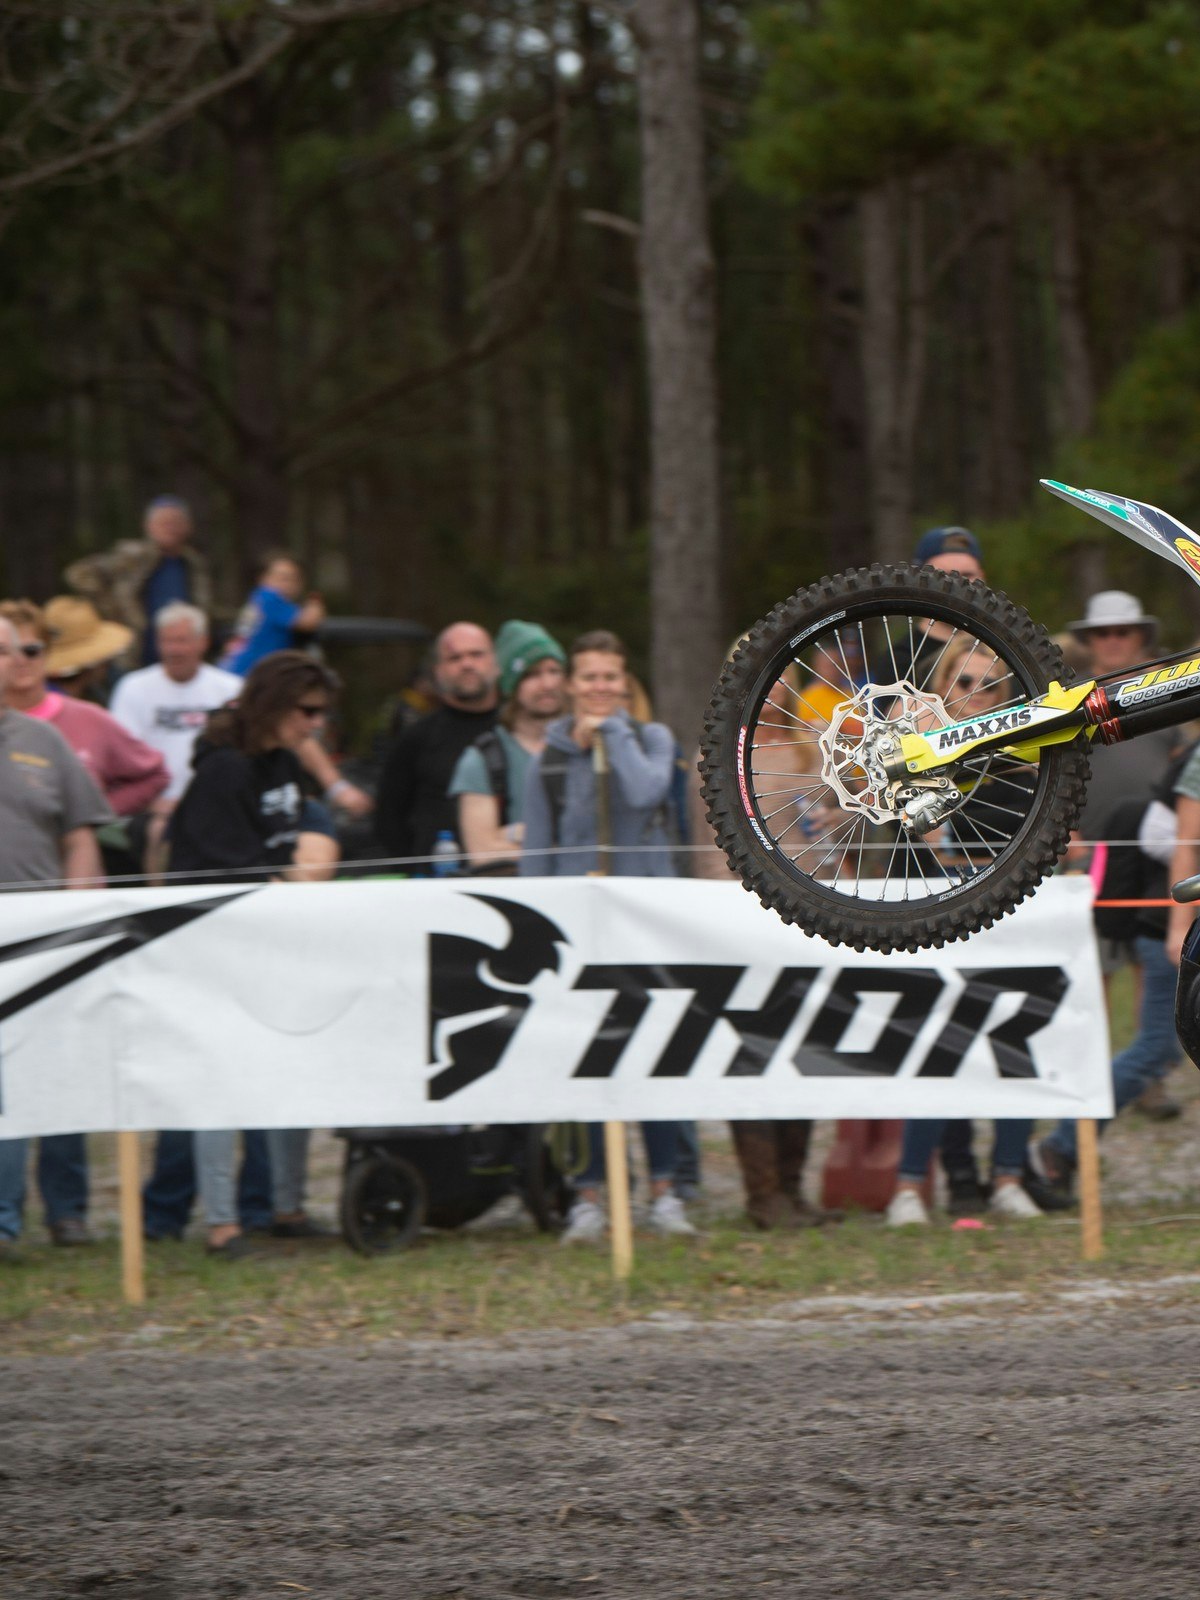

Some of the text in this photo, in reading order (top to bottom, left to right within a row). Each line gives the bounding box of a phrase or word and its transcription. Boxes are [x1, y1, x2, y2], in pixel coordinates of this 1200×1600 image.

[1074, 489, 1111, 508] MOTOREX
[938, 708, 1032, 750] MAXXIS
[749, 816, 774, 851] EQUIPPED
[570, 964, 1072, 1078] THOR
